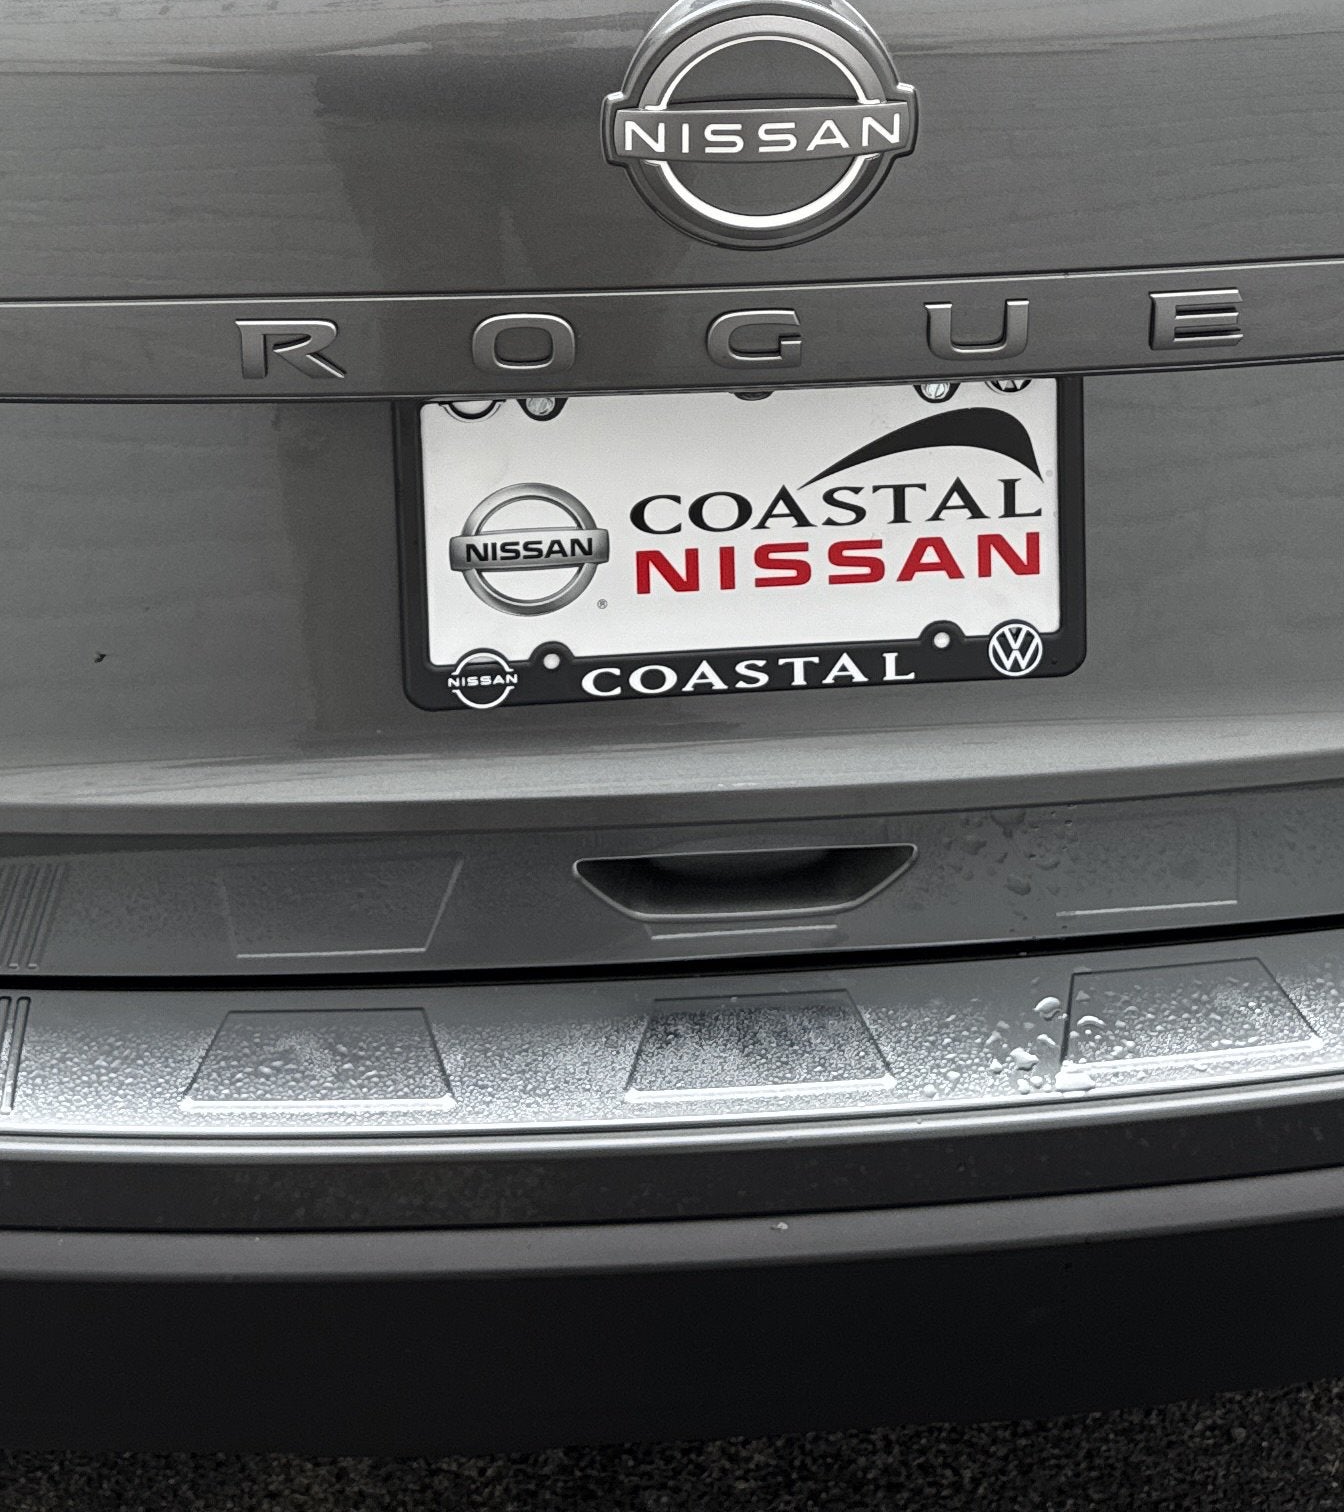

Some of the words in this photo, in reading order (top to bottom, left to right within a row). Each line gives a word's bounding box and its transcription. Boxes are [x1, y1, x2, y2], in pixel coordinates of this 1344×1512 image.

[624, 112, 900, 154] NISSAN
[234, 287, 1245, 381] ROGUE
[631, 476, 1044, 535] COASTAL
[464, 536, 595, 563] NISSAN
[634, 531, 1041, 595] NISSAN
[447, 672, 518, 688] NISSAN
[581, 651, 916, 697] COASTAL
